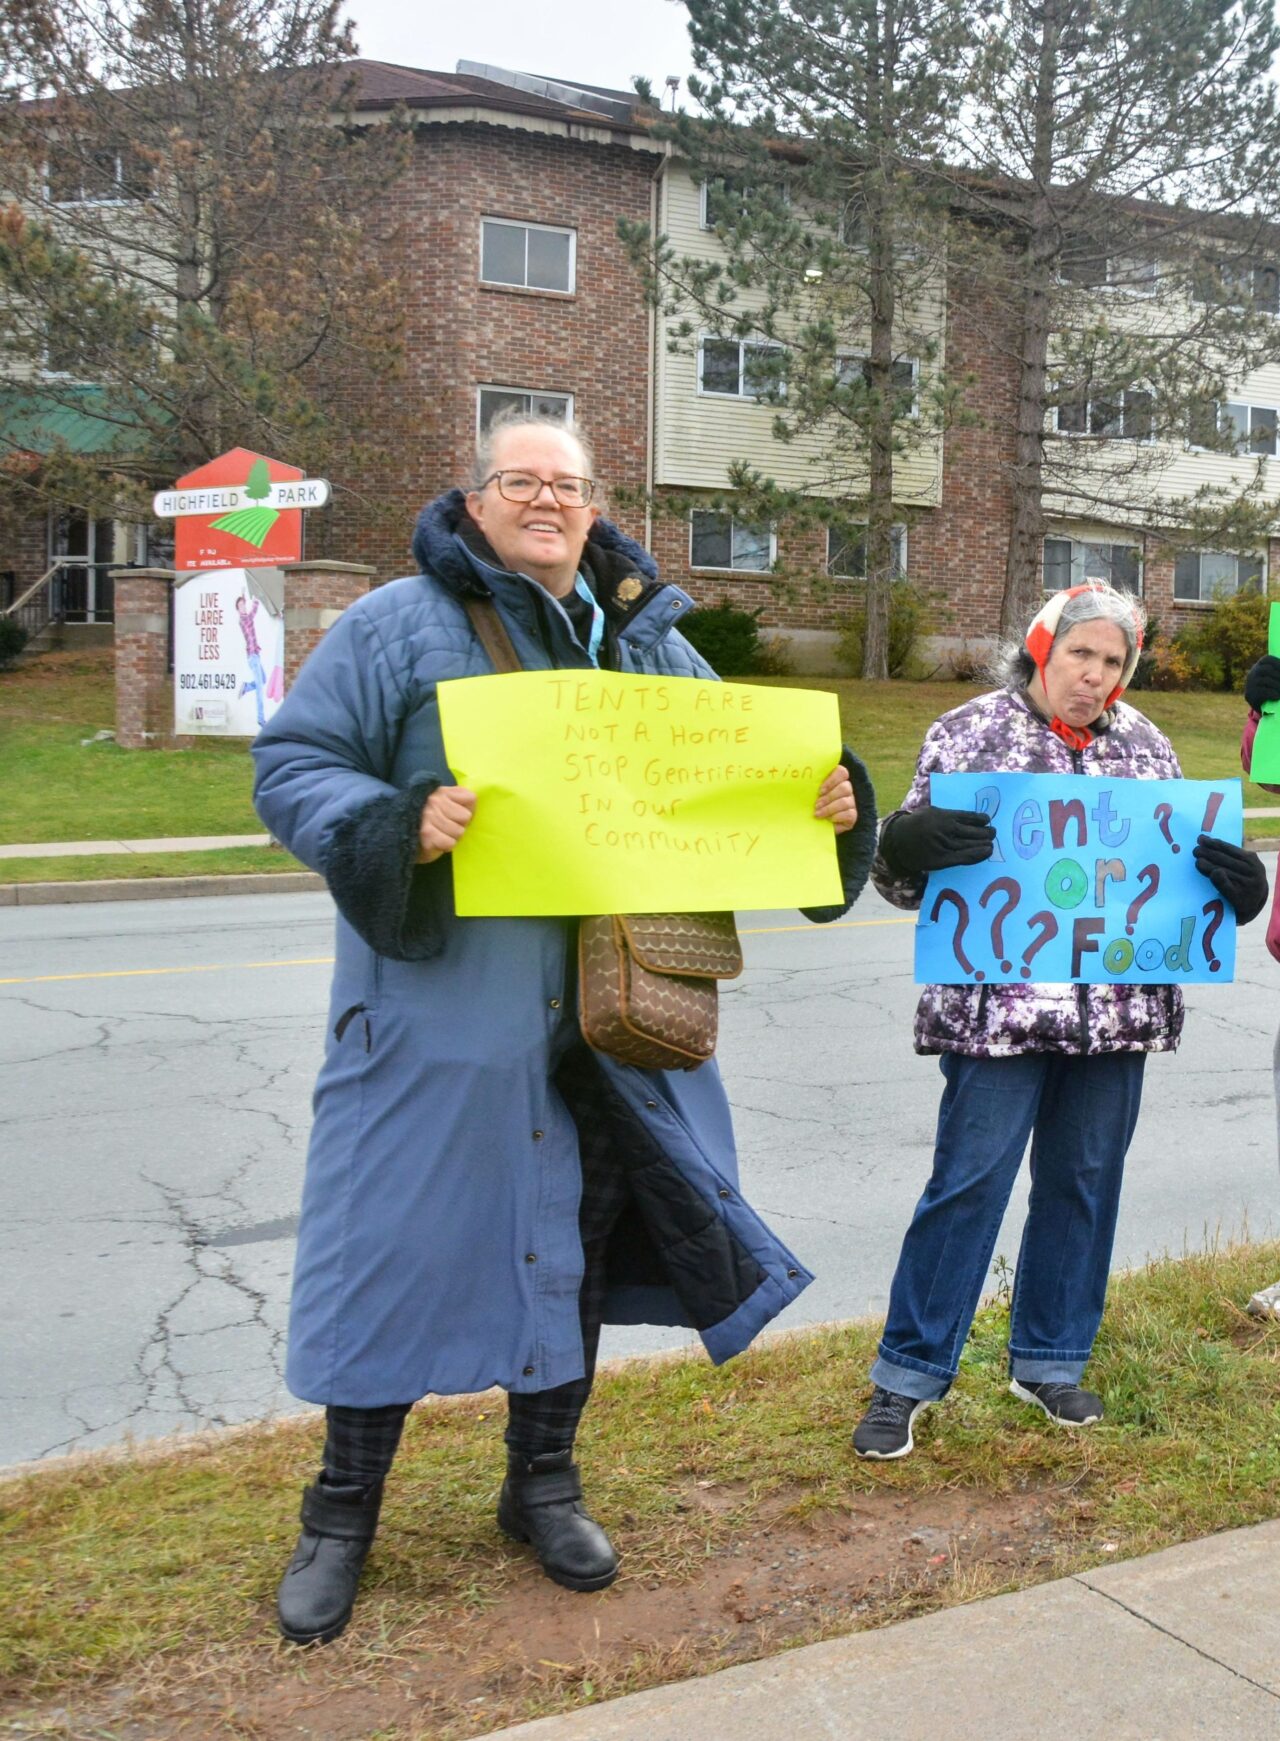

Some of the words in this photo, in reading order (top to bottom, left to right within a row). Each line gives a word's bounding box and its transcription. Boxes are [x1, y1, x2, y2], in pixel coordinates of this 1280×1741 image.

[163, 493, 239, 511] HIGHFIELD
[278, 487, 318, 503] PARK
[200, 592, 219, 608] LIVE
[195, 610, 224, 626] LARGE
[200, 627, 218, 643] FOR
[198, 645, 220, 660] LESS
[180, 673, 236, 690] 902.461.9429
[548, 679, 670, 713] TENTS
[695, 688, 754, 712] ARE
[634, 722, 651, 743] A
[563, 753, 629, 782] STOP
[644, 758, 813, 787] Gentrification
[578, 792, 612, 814] IN
[974, 786, 1131, 862] Rent
